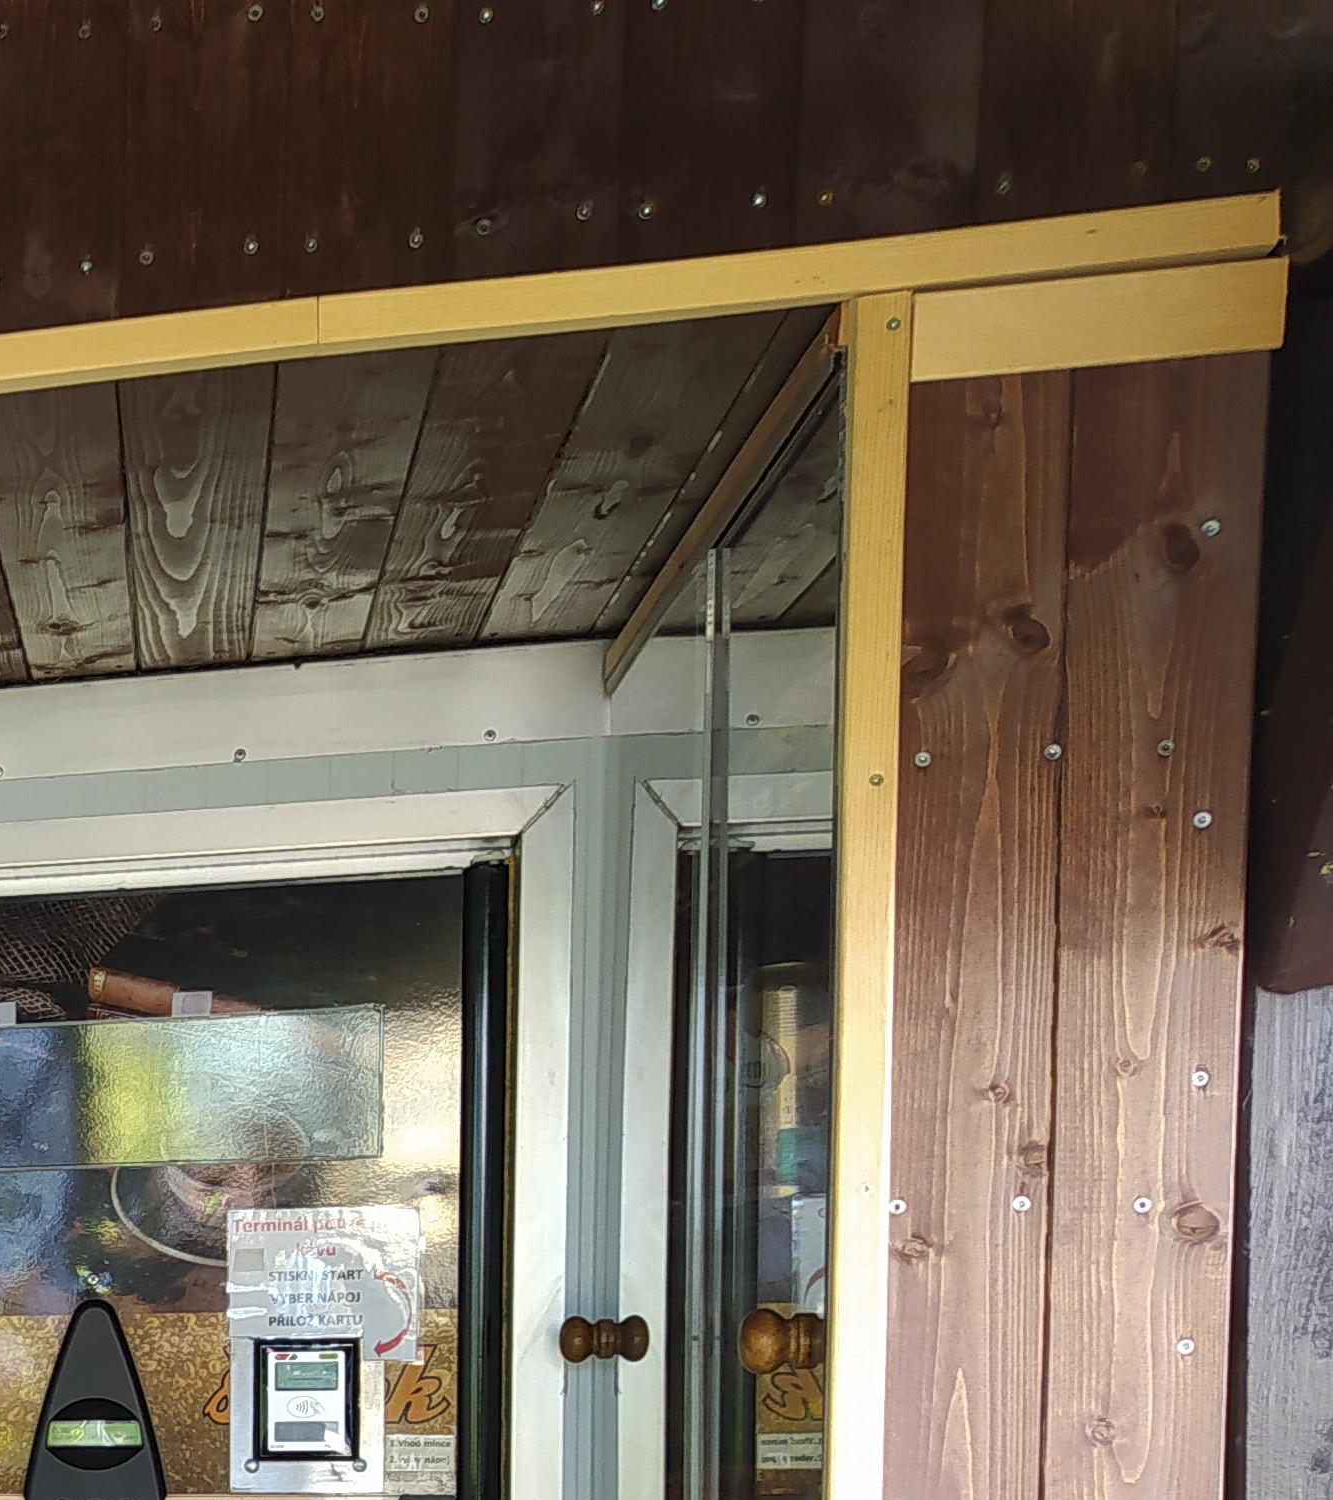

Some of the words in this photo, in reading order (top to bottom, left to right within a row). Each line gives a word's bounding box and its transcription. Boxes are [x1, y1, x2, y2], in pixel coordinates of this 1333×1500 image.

[233, 1216, 308, 1233] Terminál
[322, 1269, 364, 1281] START
[318, 1315, 363, 1326] KARTU
